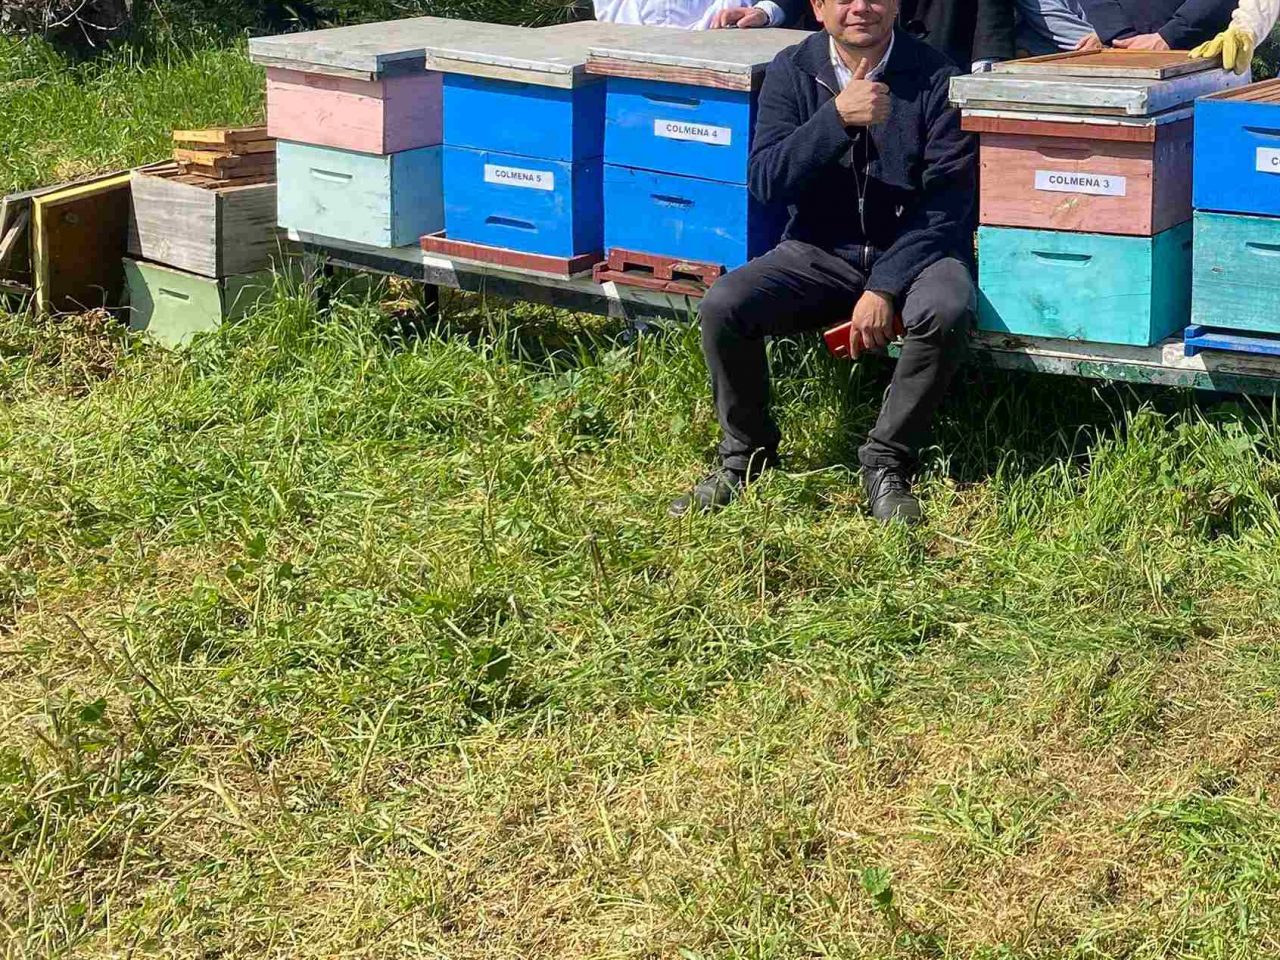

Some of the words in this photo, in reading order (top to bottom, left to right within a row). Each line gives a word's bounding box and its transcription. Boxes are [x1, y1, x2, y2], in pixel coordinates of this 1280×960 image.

[665, 123, 710, 137] COLMENA
[711, 129, 718, 138] 4
[494, 169, 534, 182] COLMENA
[536, 174, 542, 183] 5
[1048, 175, 1100, 188] COLMENA
[1103, 179, 1110, 188] 3
